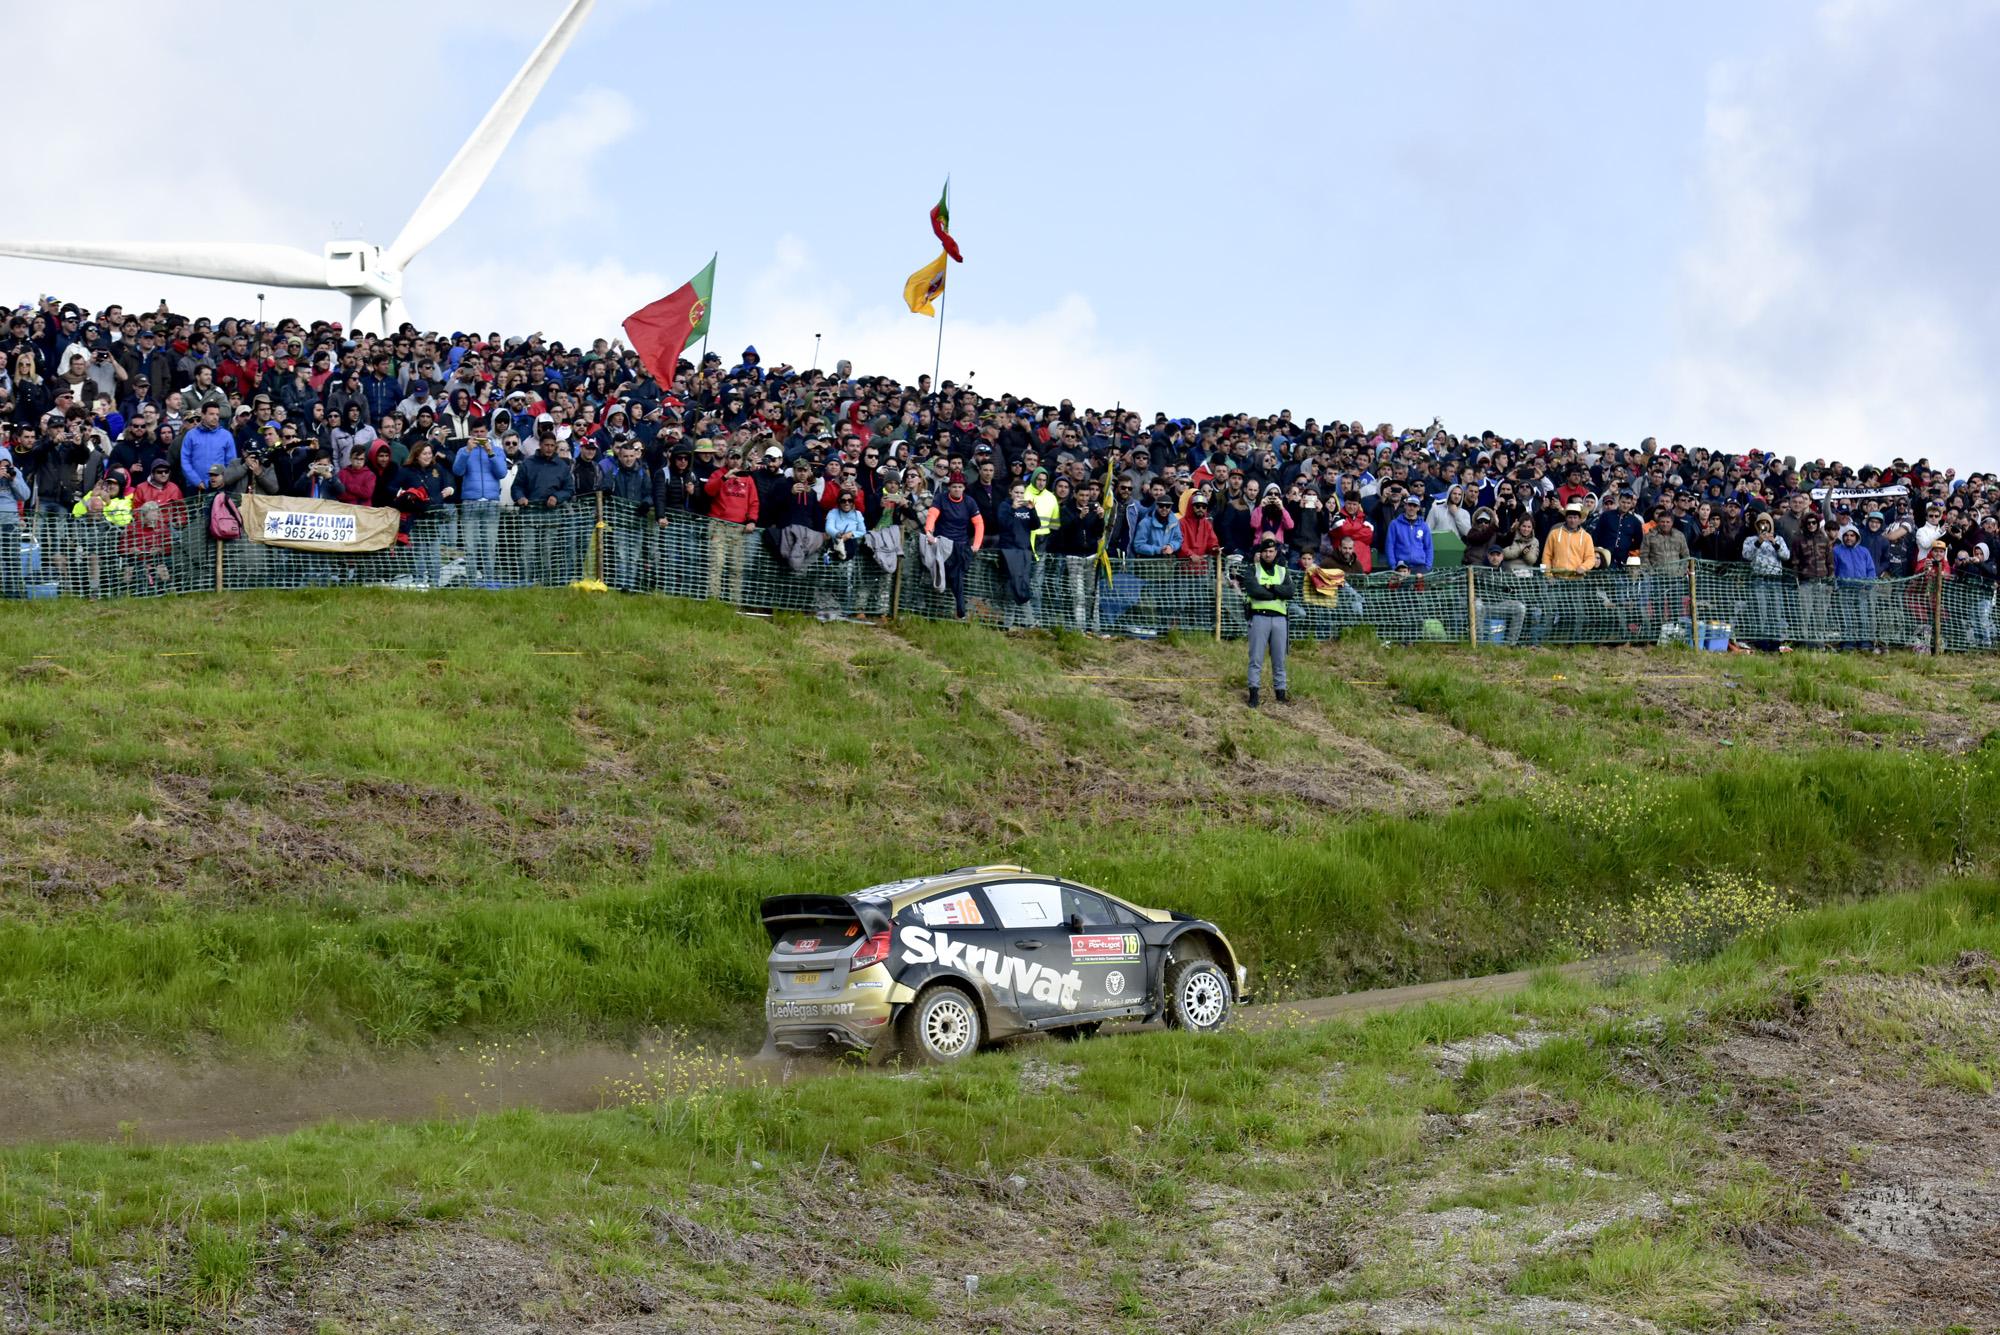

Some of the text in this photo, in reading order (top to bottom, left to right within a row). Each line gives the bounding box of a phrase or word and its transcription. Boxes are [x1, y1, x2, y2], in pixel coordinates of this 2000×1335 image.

[284, 526, 353, 541] 965 246 397
[956, 898, 981, 925] 16
[844, 923, 859, 937] 16
[1088, 941, 1121, 949] Portugal
[1123, 935, 1138, 954] 16
[900, 925, 1082, 1010] Skruvat
[771, 1001, 855, 1020] LeoVegas SPORT
